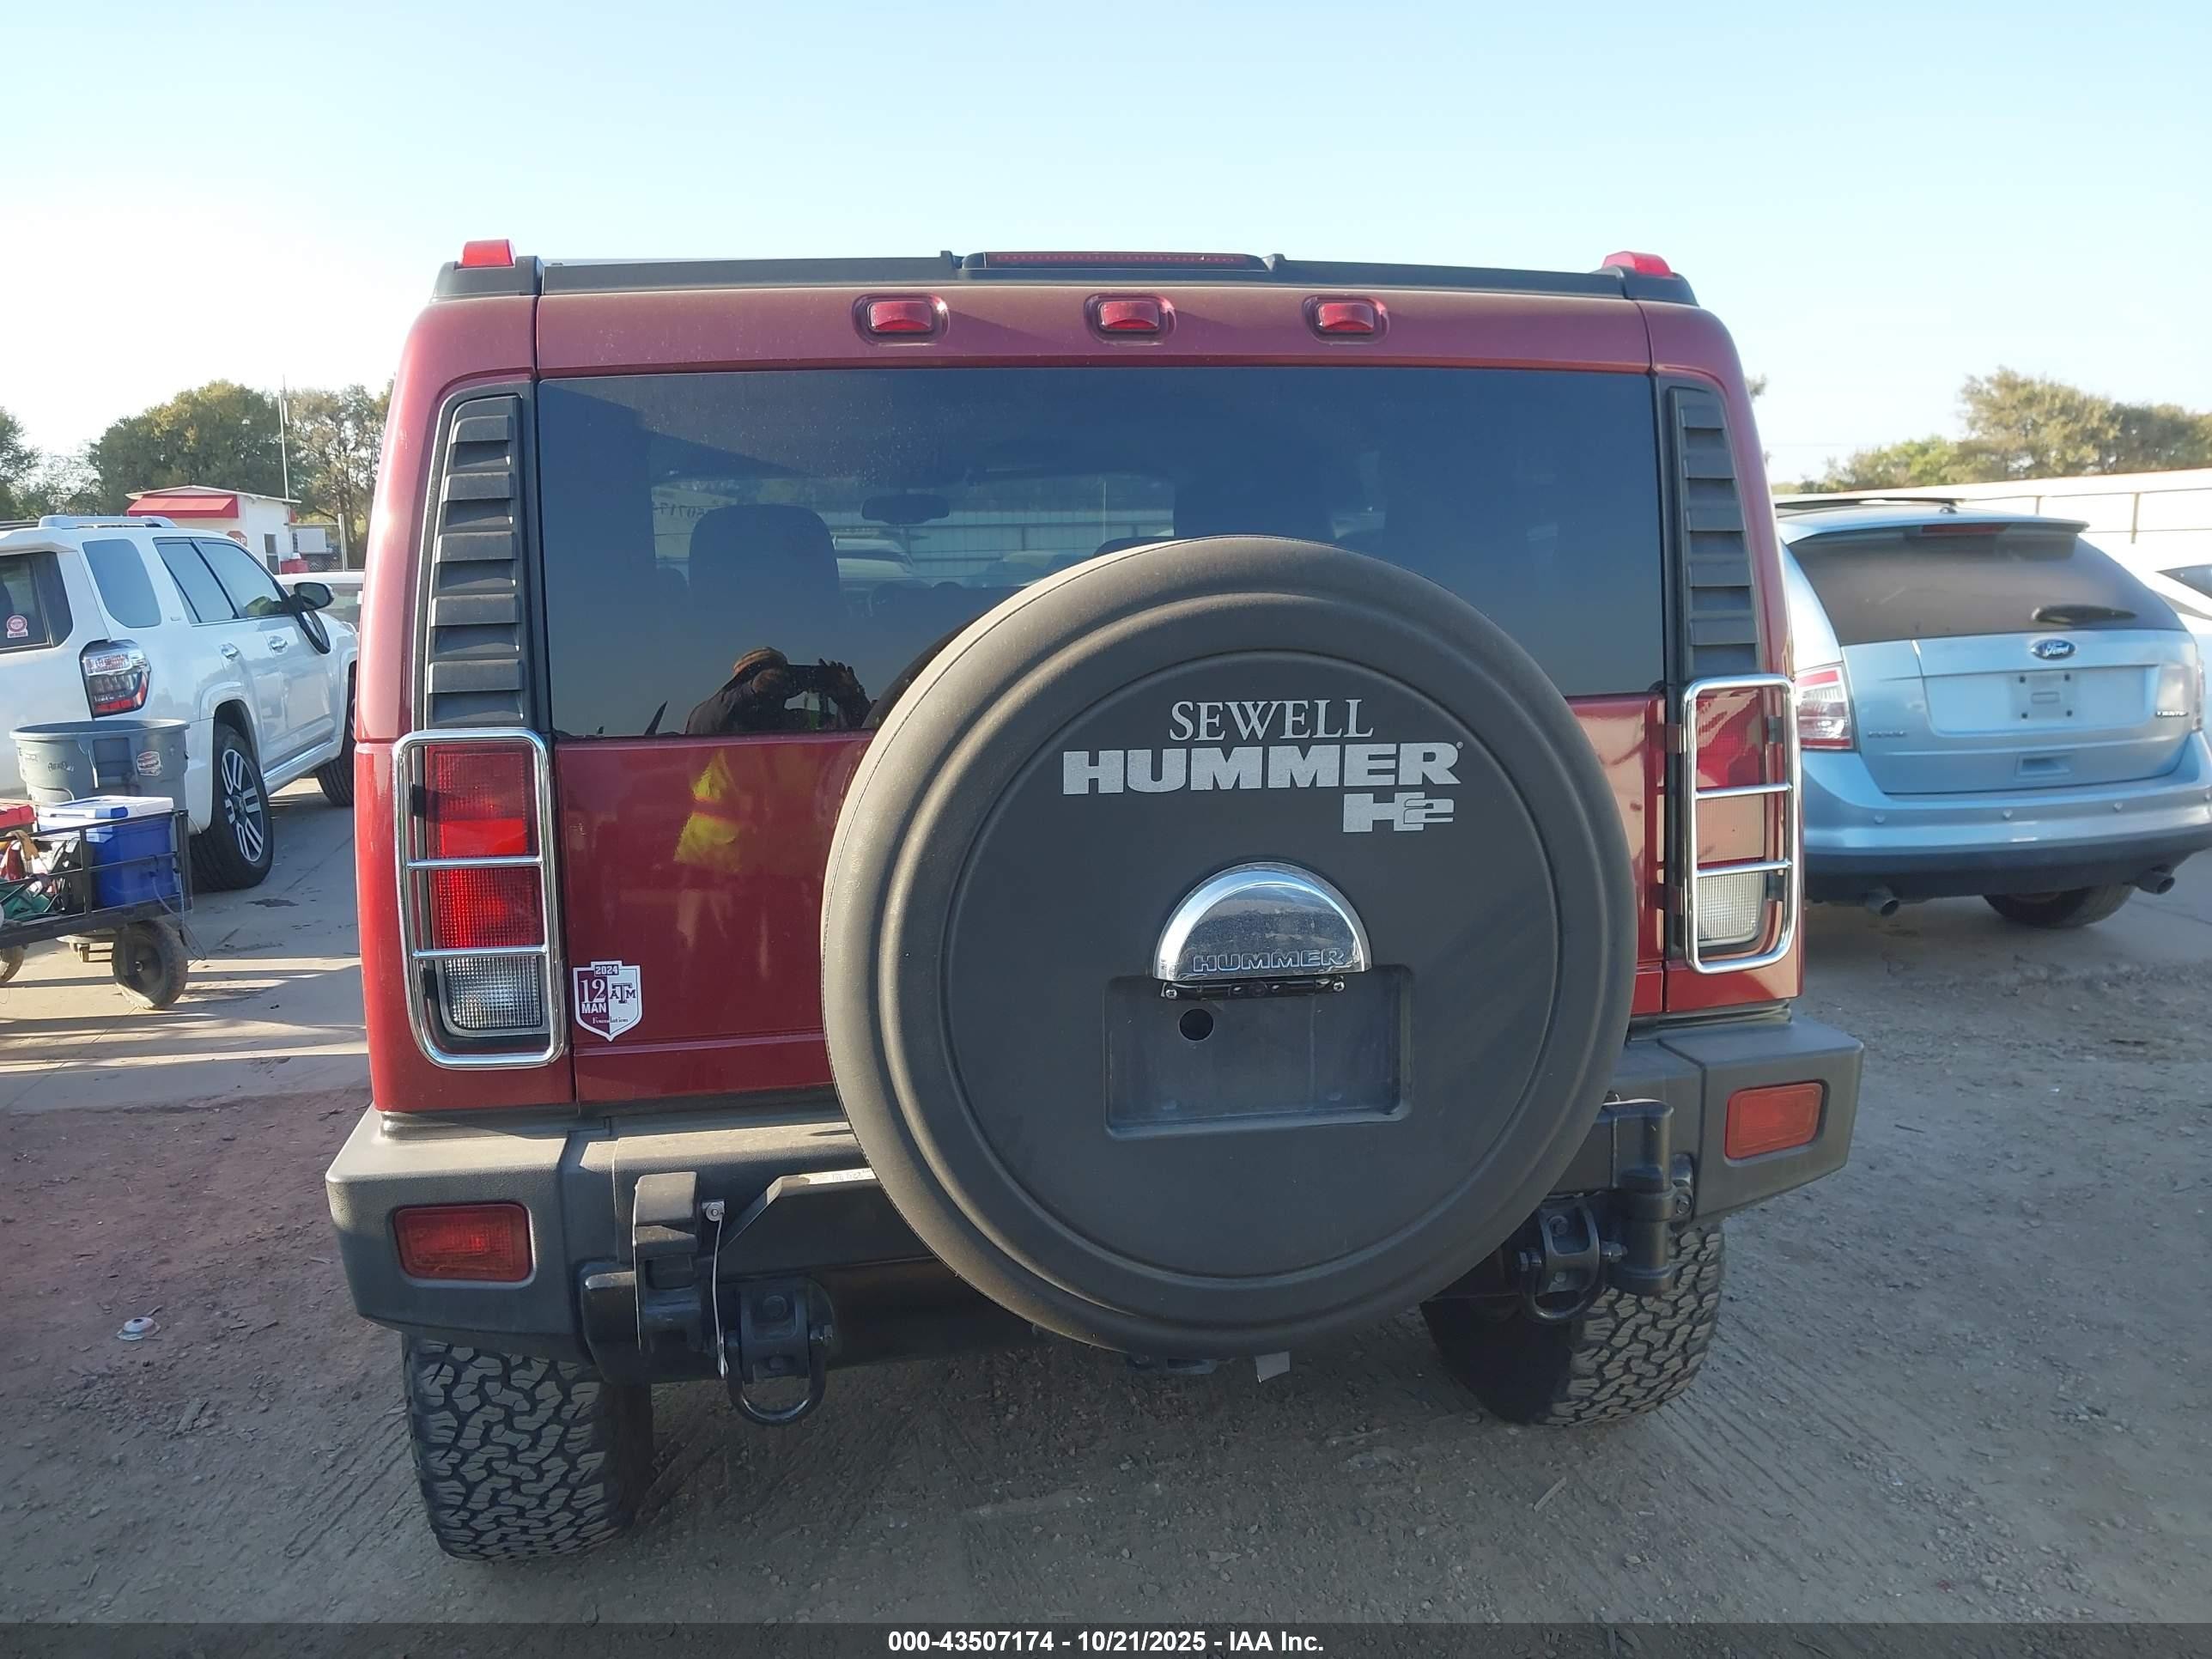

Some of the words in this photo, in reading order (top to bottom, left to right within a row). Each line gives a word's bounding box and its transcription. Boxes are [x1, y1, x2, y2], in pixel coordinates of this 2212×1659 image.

[1169, 699, 1374, 741] SEWELL
[1343, 792, 1455, 833] H2
[595, 965, 618, 975] 2024
[1193, 948, 1346, 973] HUMMER
[581, 1003, 607, 1014] MAN
